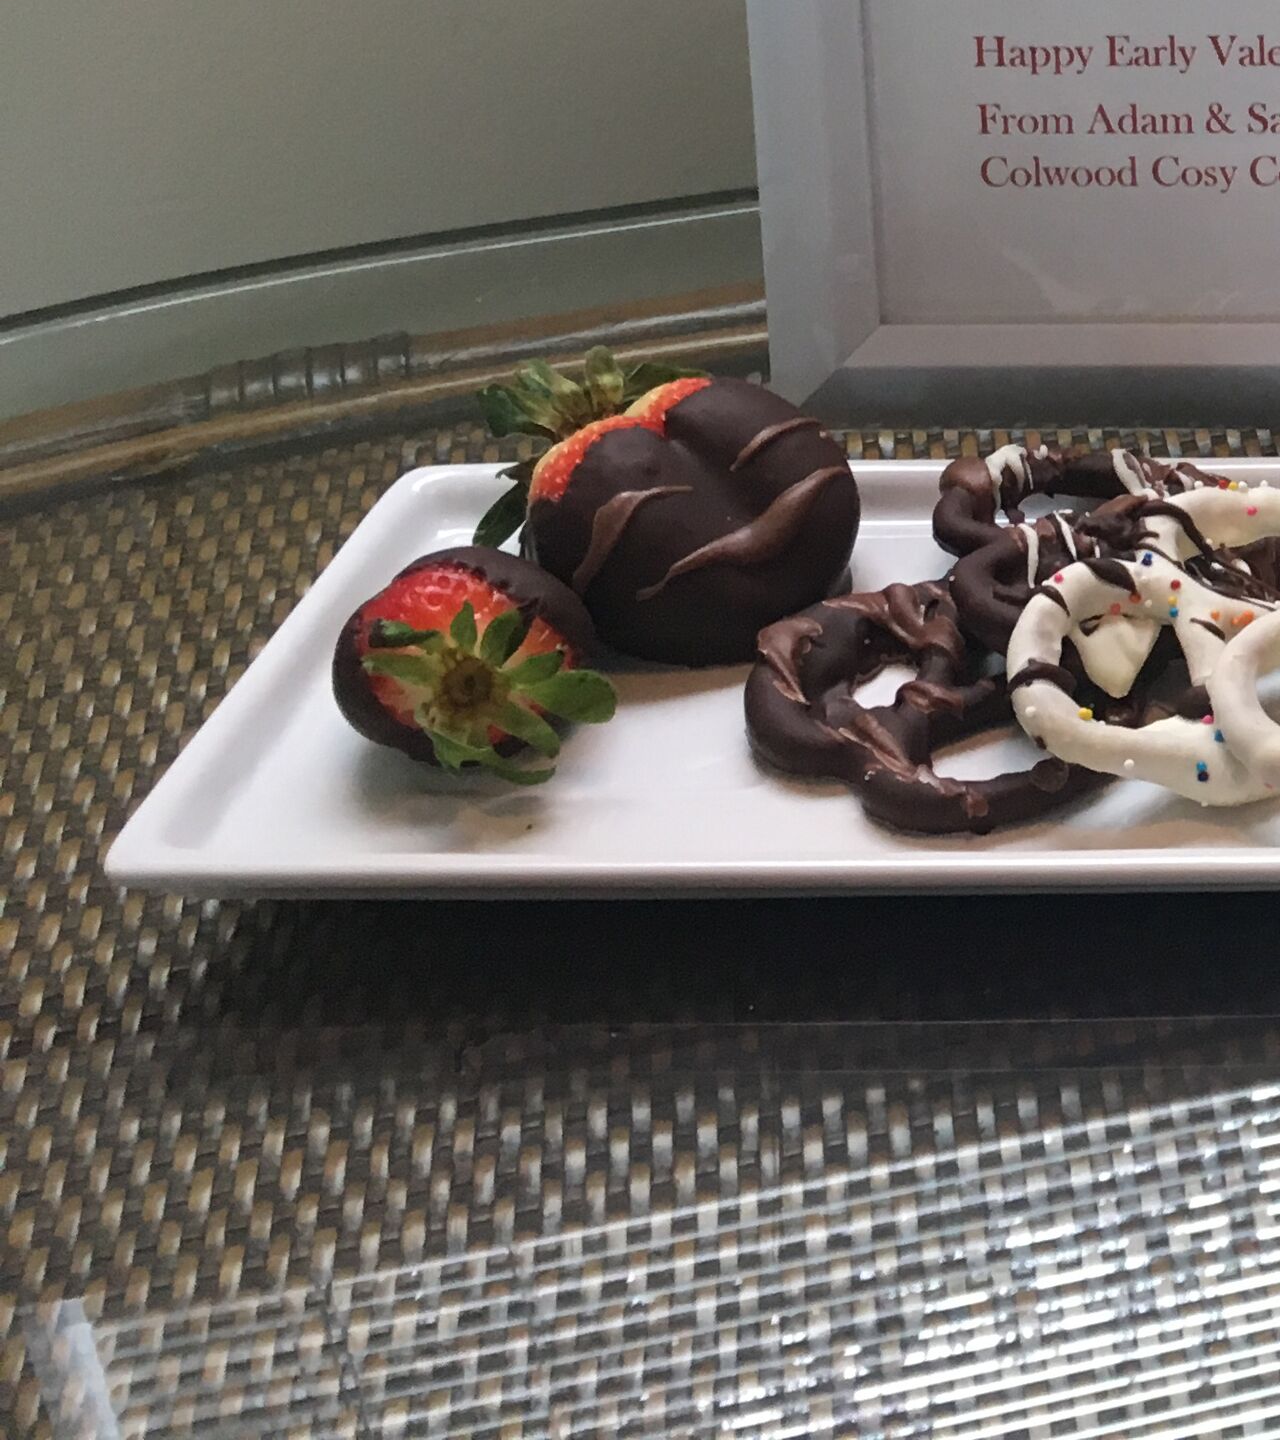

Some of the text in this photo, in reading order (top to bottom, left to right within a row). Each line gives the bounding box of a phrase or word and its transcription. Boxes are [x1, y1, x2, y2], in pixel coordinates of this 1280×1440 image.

[973, 34, 1094, 75] Happy
[1106, 34, 1198, 74] Early
[977, 102, 1075, 136] From
[1086, 101, 1195, 136] Adam
[1204, 102, 1236, 136] &
[980, 155, 1139, 189] Colwood
[1151, 156, 1238, 194] Cosy
